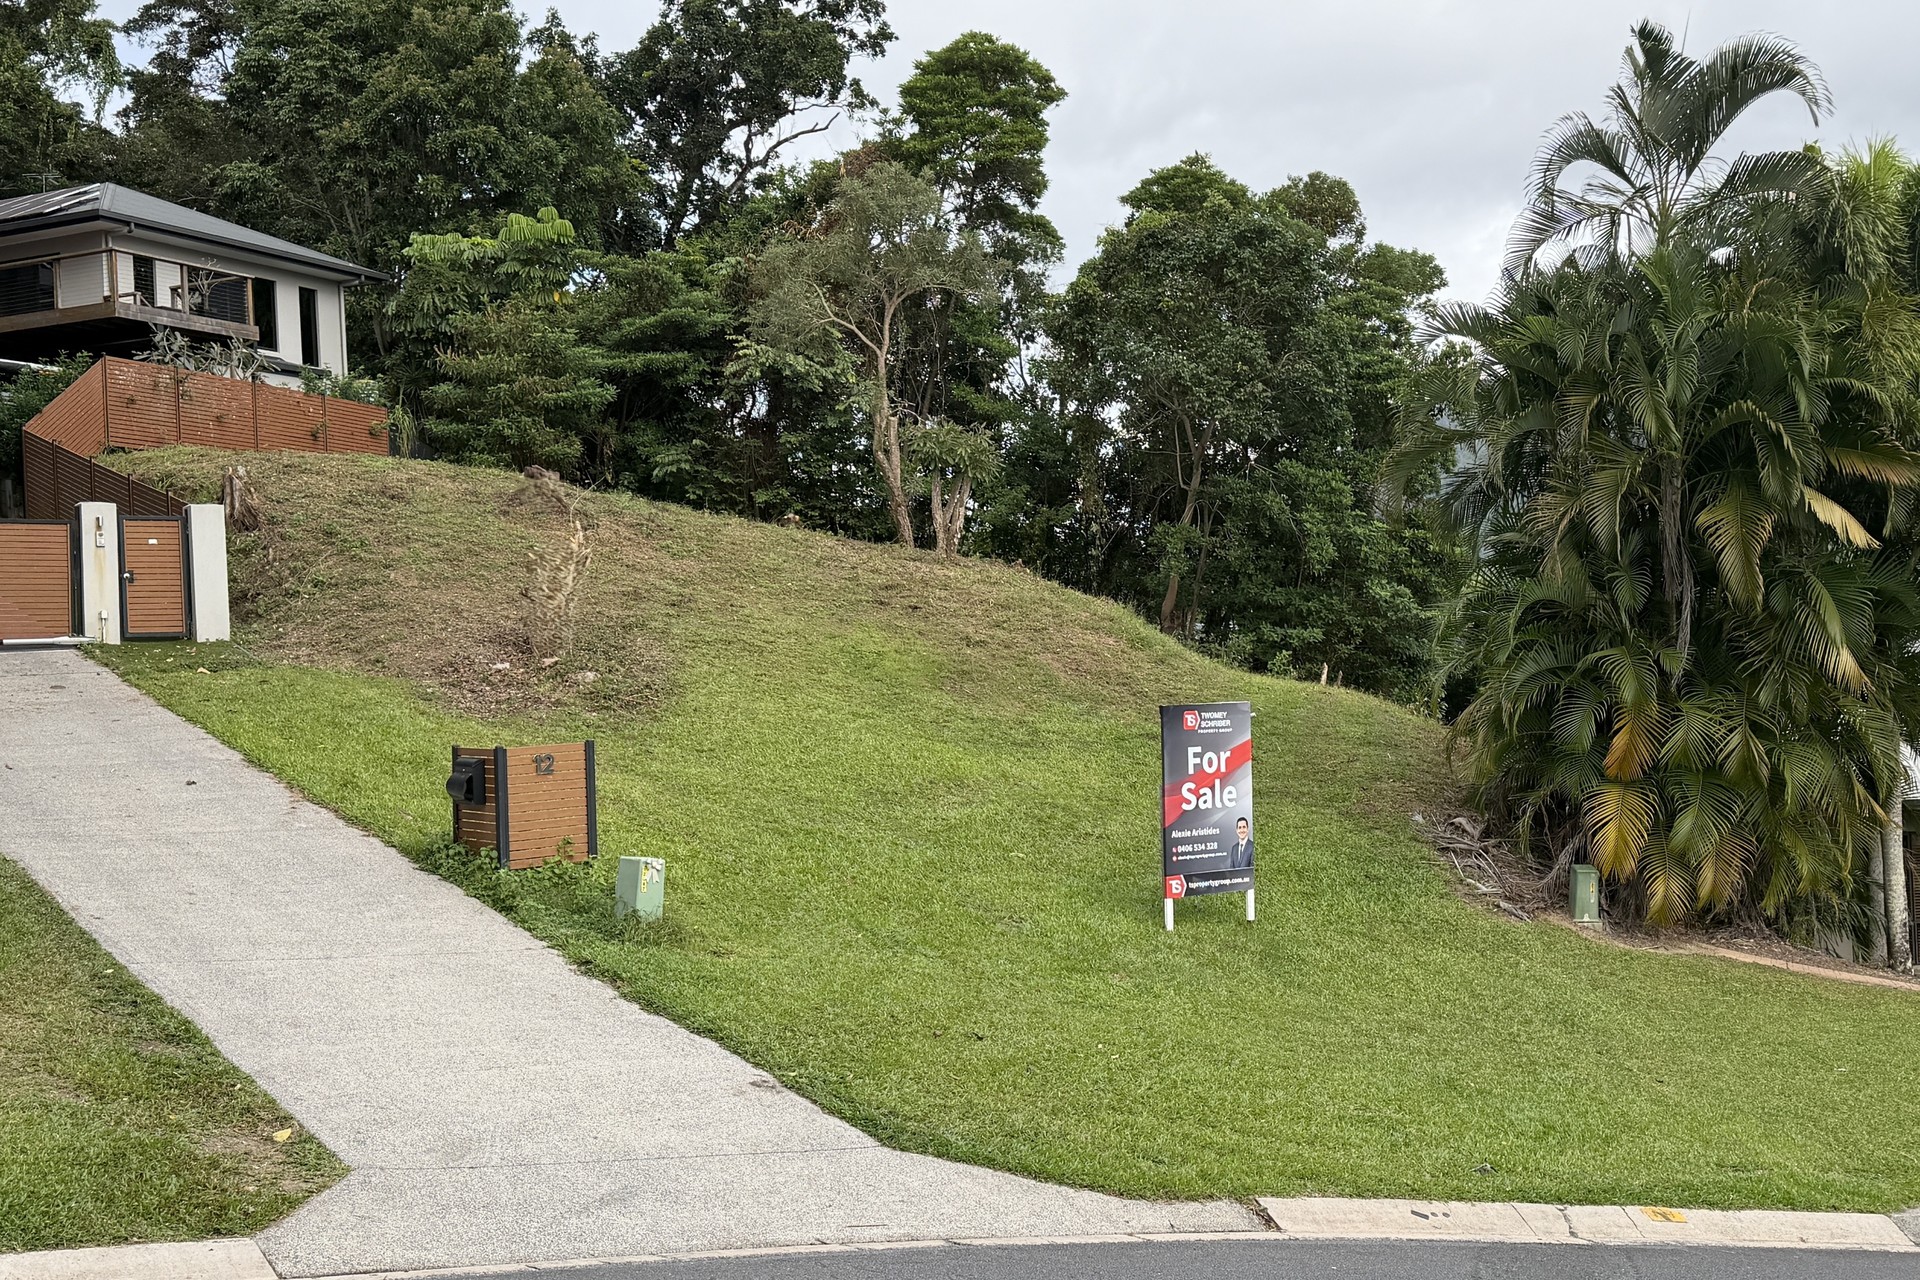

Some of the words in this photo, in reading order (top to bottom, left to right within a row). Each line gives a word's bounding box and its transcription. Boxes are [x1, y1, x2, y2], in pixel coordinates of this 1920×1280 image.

[532, 754, 554, 775] 12
[1187, 746, 1231, 775] For
[1181, 779, 1237, 811] Sale
[1177, 844, 1193, 853] 0406
[1194, 843, 1205, 851] 534
[1206, 842, 1218, 850] 328
